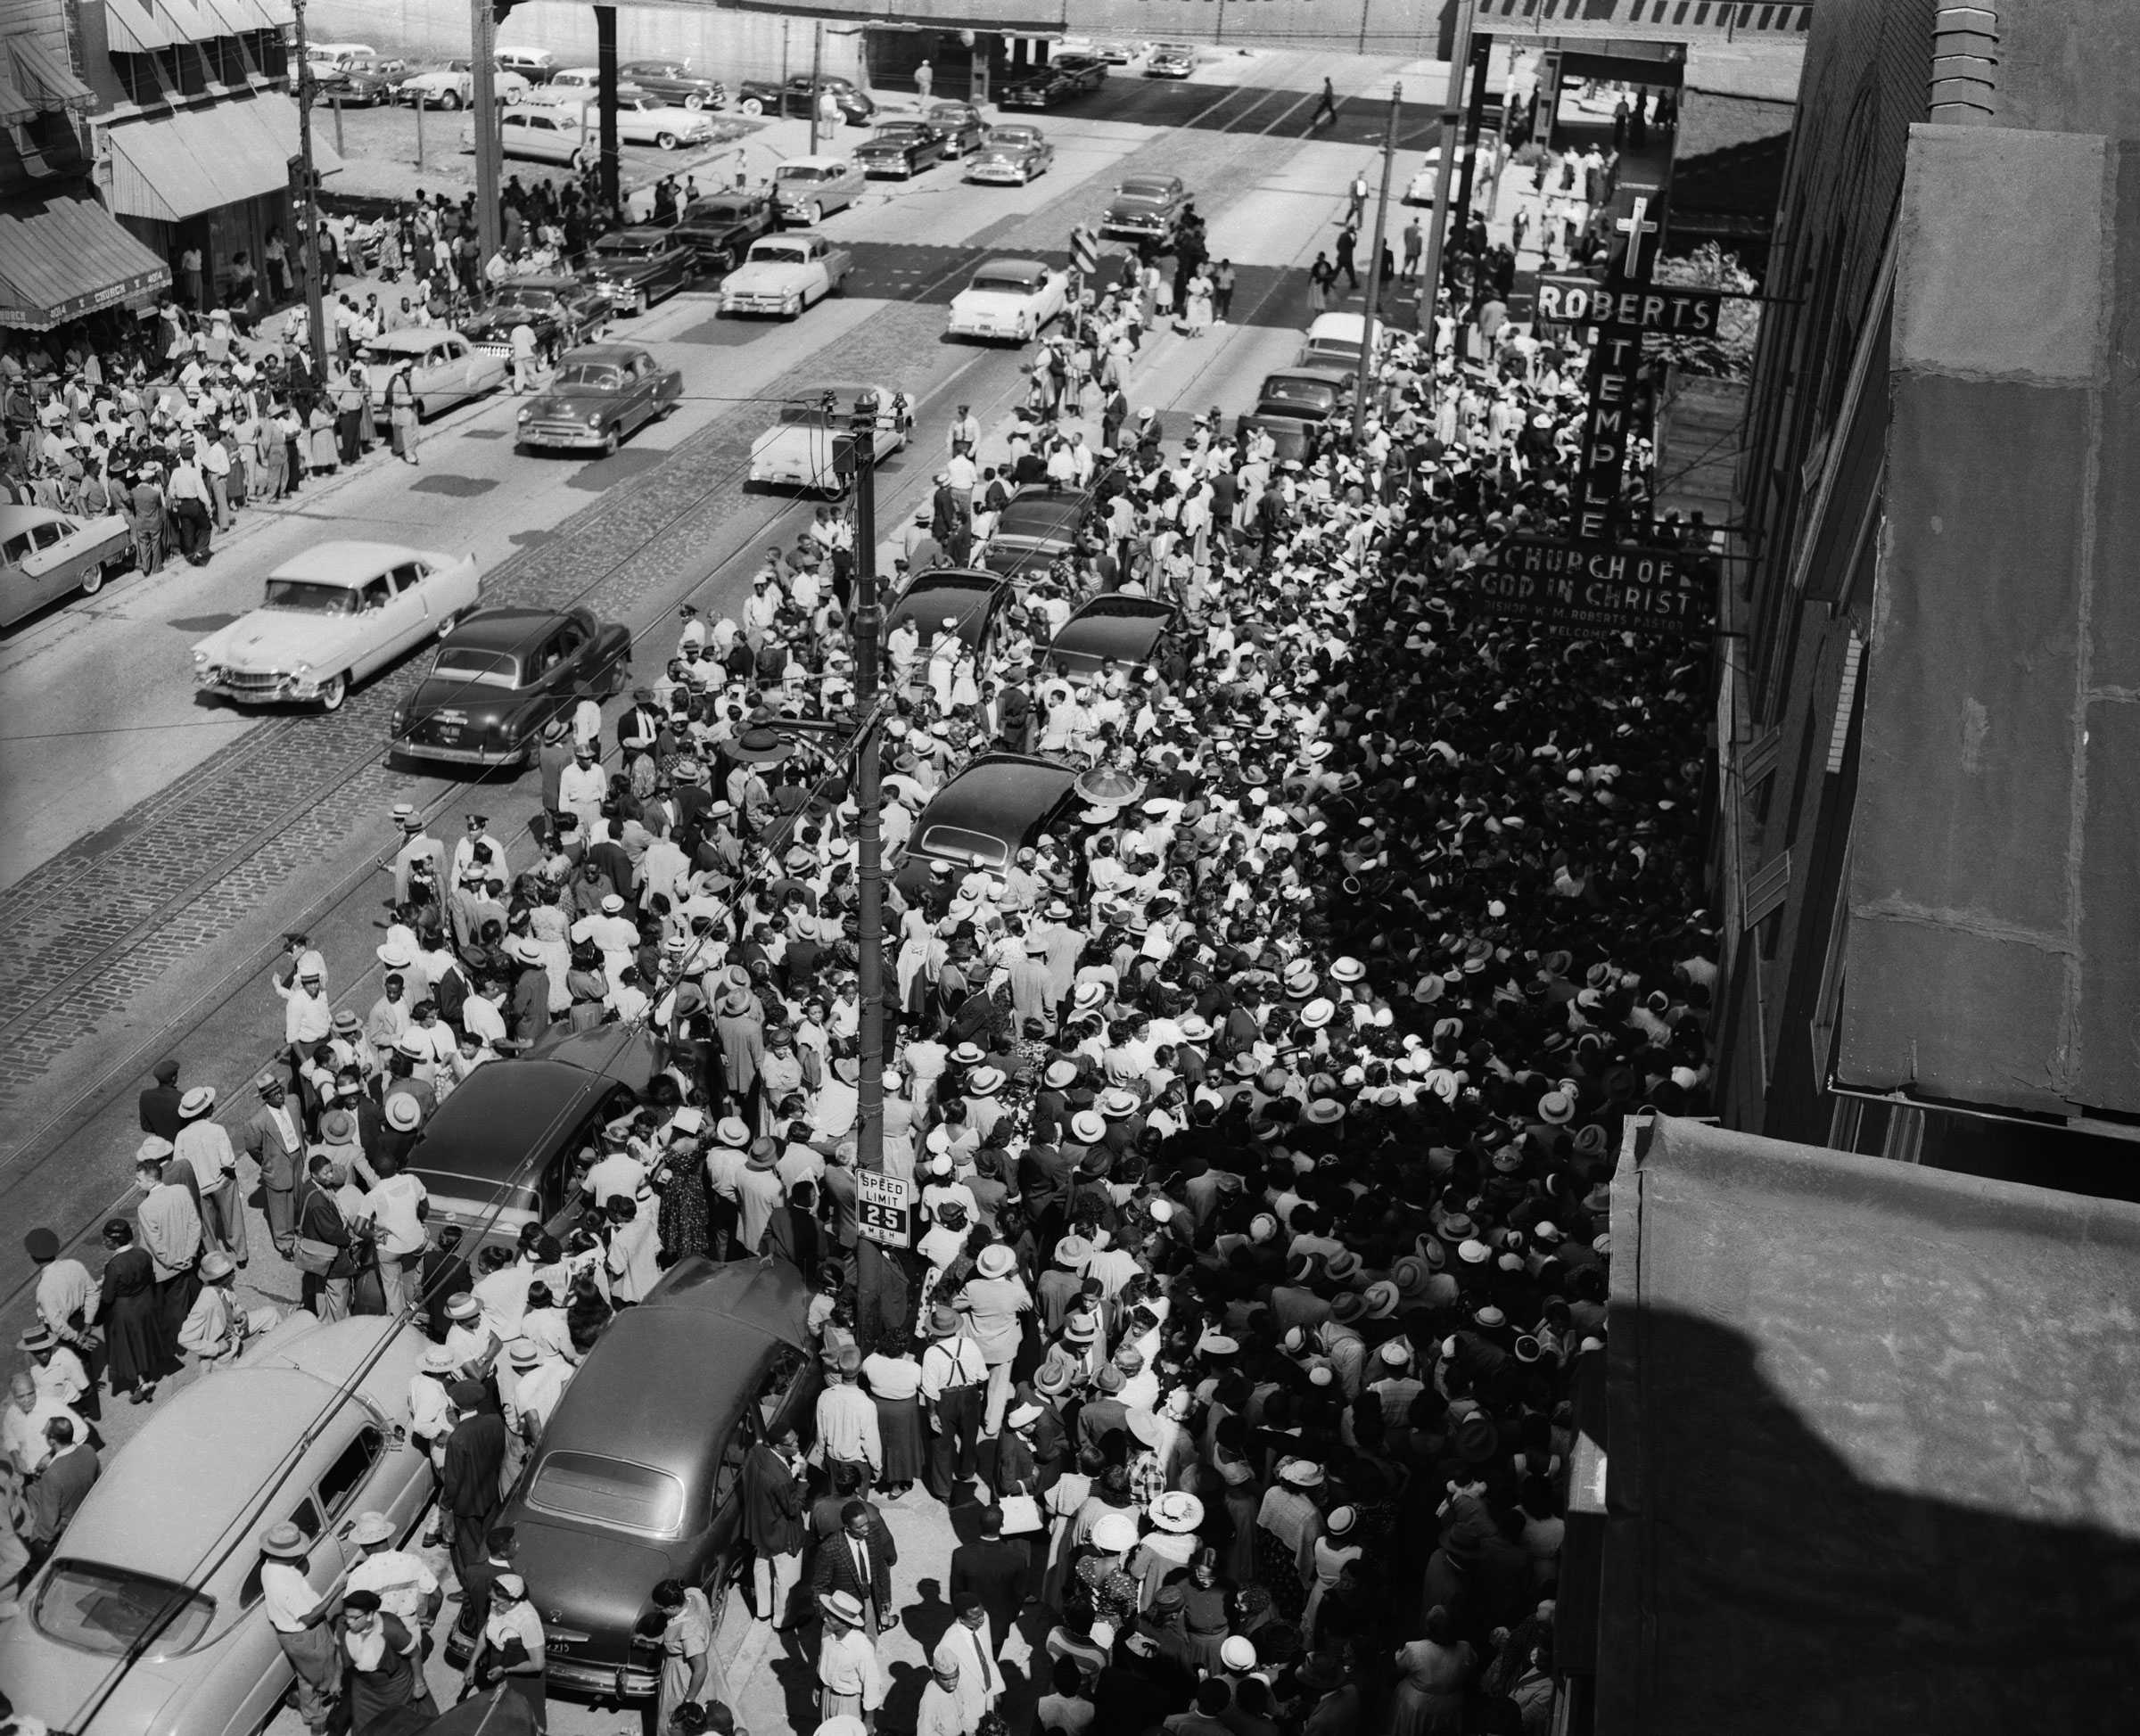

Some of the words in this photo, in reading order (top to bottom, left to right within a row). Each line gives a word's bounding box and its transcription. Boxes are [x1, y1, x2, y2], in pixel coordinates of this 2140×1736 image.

[95, 284, 127, 302] CHURCH
[1538, 284, 1710, 331] ROBERTS
[1580, 339, 1633, 539] TEMPLE
[1504, 546, 1627, 580] CHURCH
[1638, 558, 1675, 585] OF
[1480, 572, 1535, 598] GOD
[1547, 578, 1575, 604] IN
[1585, 583, 1691, 615] CHRIST
[1570, 609, 1627, 625] ROBERTS
[1549, 624, 1608, 640] WELCOME
[862, 1176, 903, 1195] SPEED
[866, 1190, 898, 1206] LIMIT
[867, 1205, 898, 1230] 25
